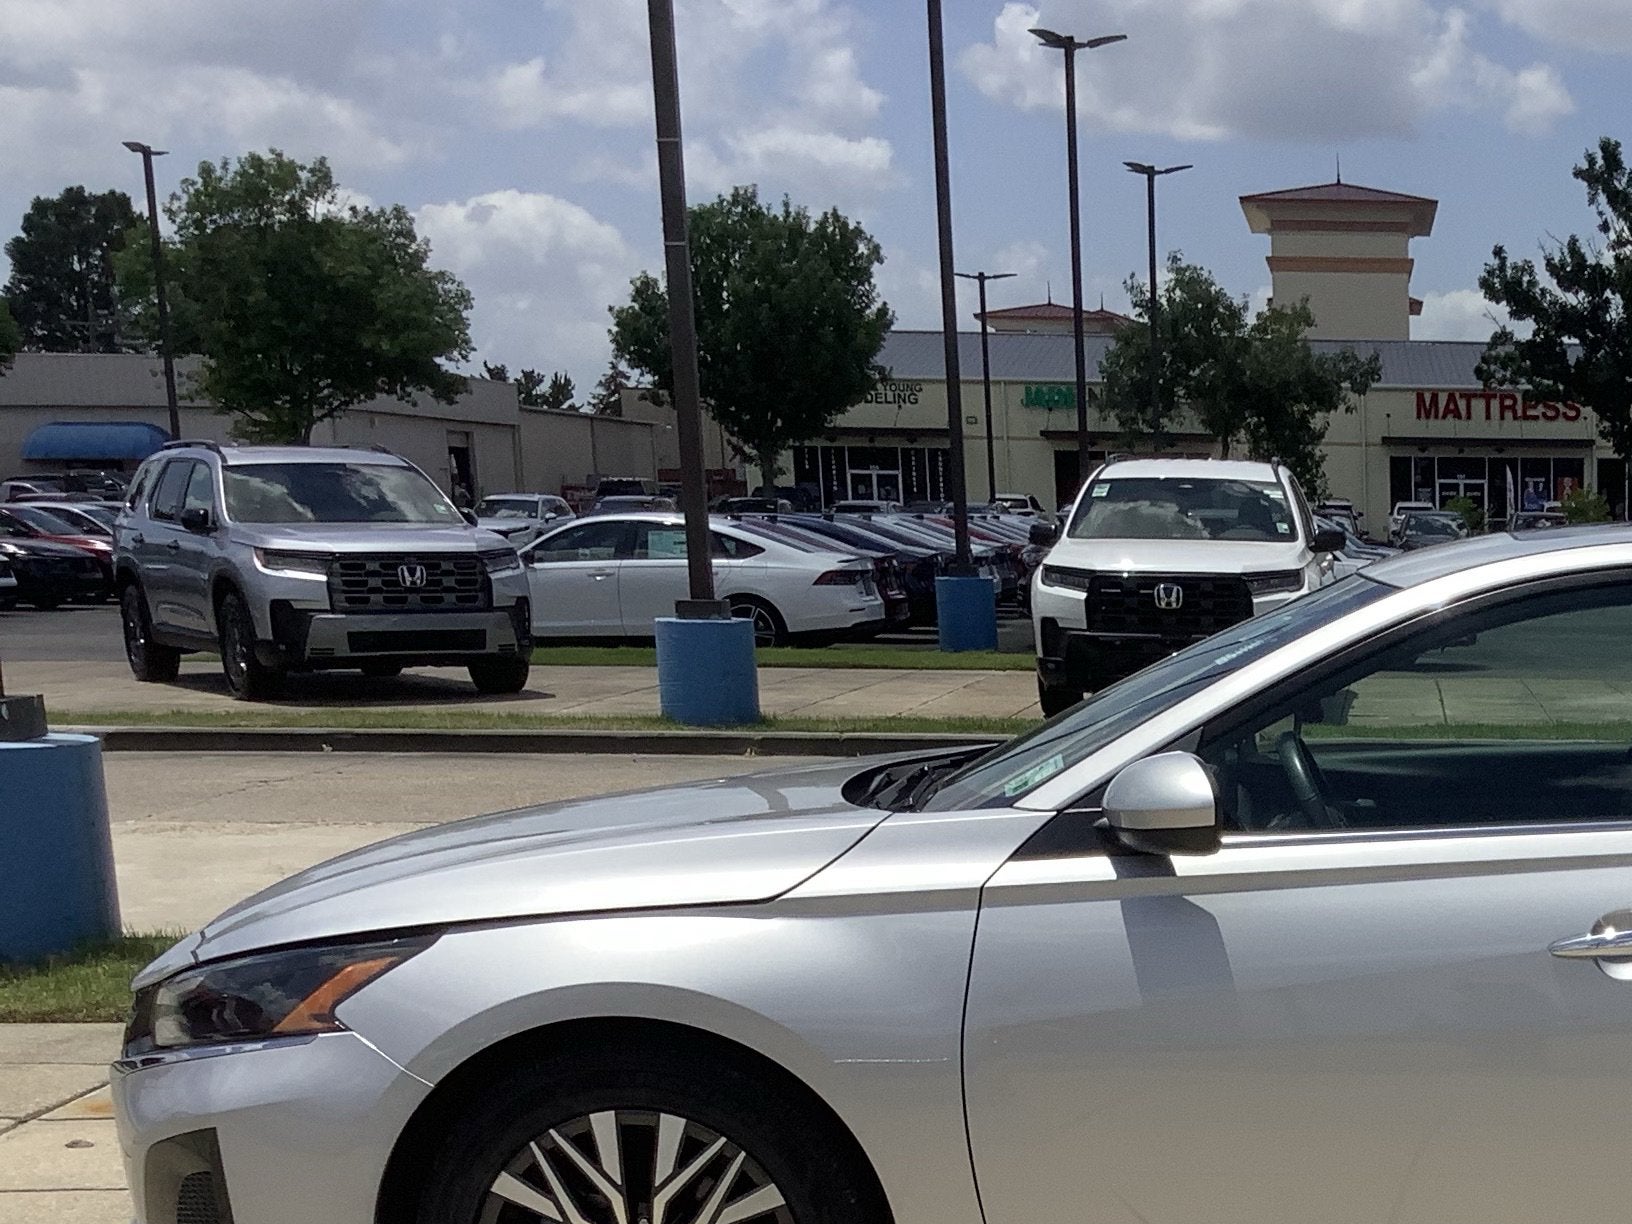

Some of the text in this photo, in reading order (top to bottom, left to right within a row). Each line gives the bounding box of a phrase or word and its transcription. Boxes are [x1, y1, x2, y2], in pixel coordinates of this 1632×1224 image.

[882, 383, 922, 393] YOUNG
[864, 392, 919, 404] DELING
[1416, 391, 1581, 421] MATTRESS
